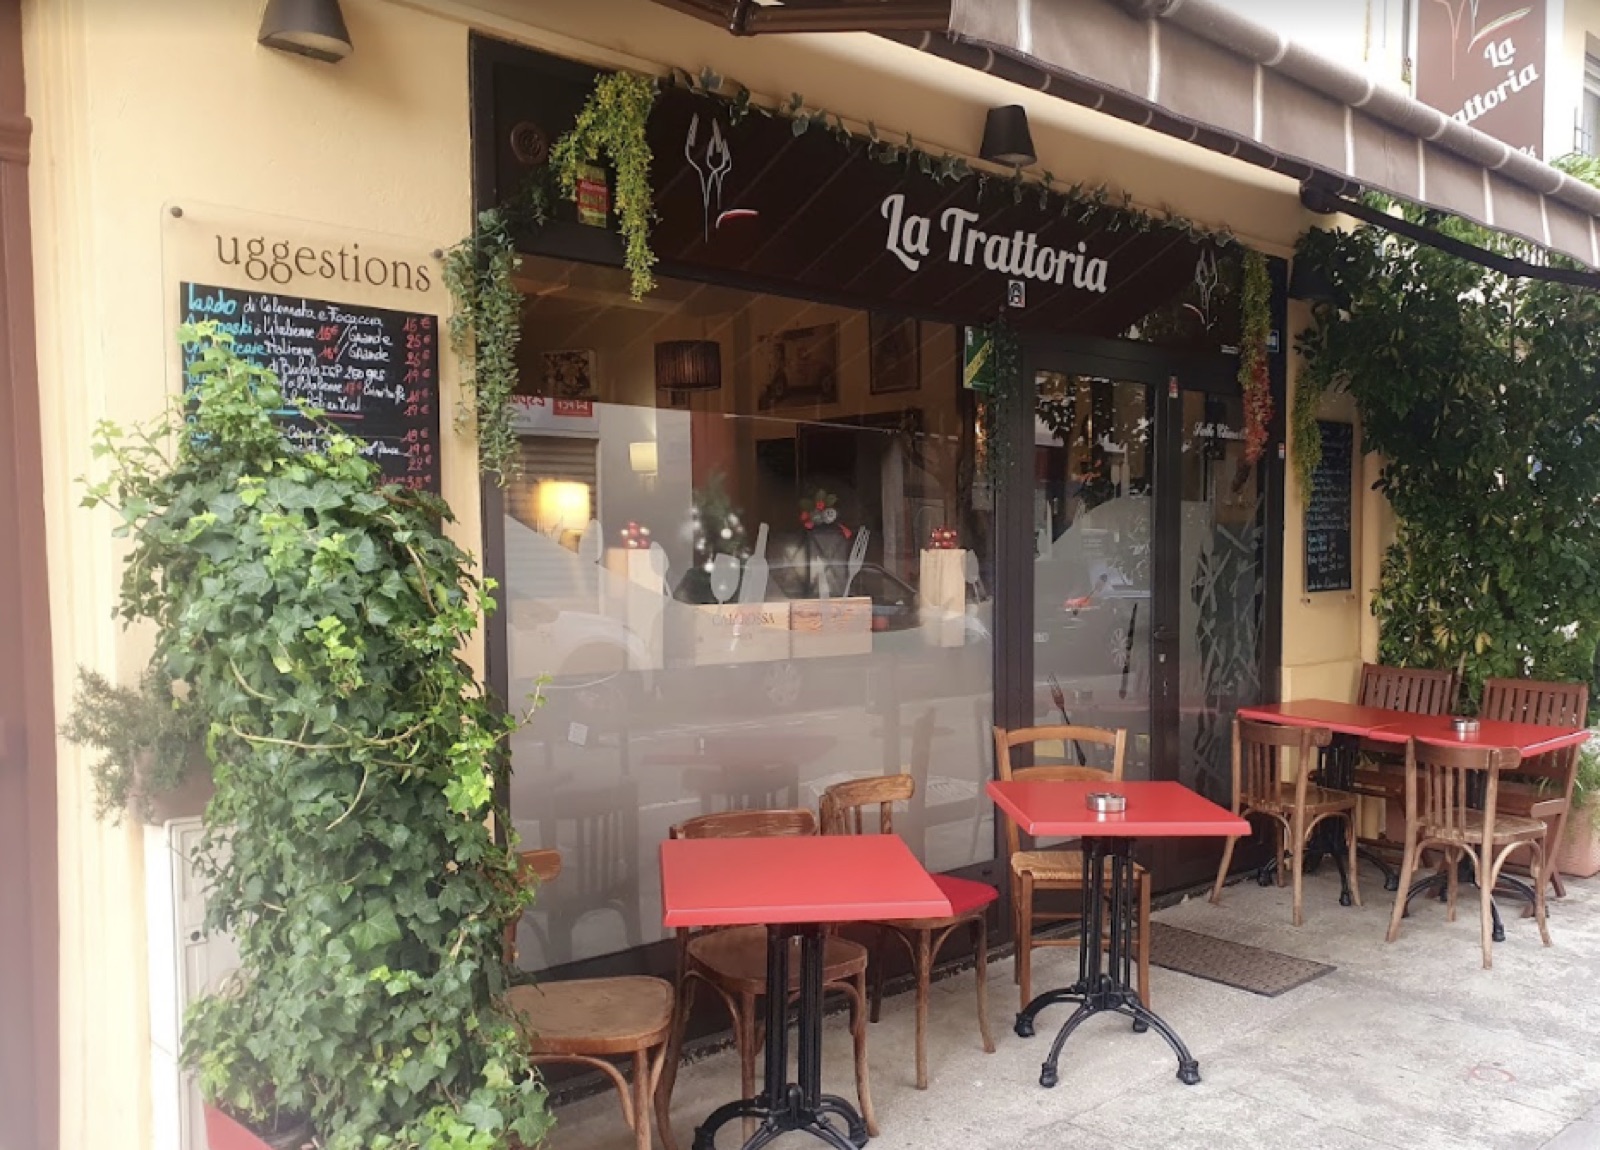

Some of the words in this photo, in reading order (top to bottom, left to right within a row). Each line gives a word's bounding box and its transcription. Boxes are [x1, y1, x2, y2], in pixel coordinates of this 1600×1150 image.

[1484, 37, 1516, 68] La
[1448, 63, 1540, 126] attoria
[215, 234, 431, 292] uggestions
[880, 193, 932, 272] La
[940, 207, 1108, 293] Trattoria
